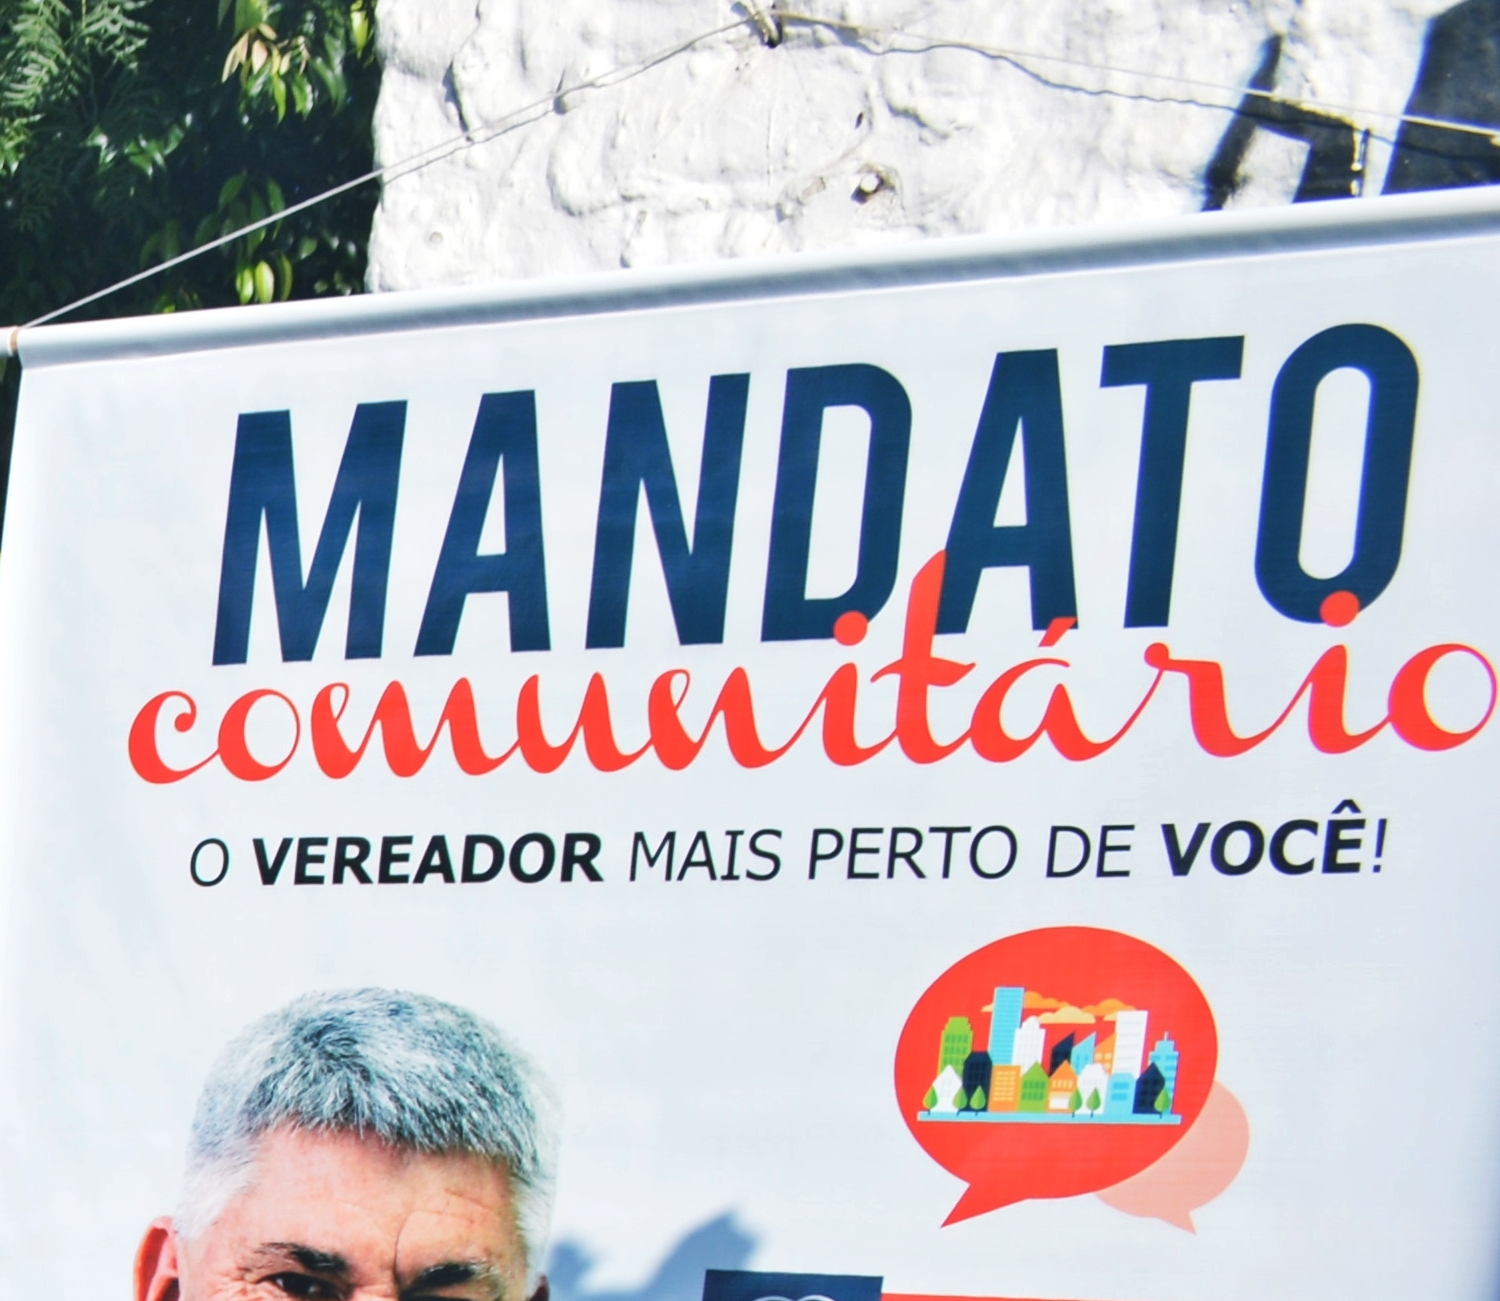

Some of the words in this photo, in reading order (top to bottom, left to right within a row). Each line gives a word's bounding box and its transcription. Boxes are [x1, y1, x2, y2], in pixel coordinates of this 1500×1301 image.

[212, 322, 1420, 666] MANDATO
[128, 550, 1498, 783] comunitário
[190, 837, 230, 887] O
[251, 832, 604, 886] VEREADOR
[628, 828, 783, 882] MAIS
[807, 826, 1018, 880] PERTO
[1045, 824, 1136, 879] DE
[1161, 799, 1388, 877] VOCÊ!
